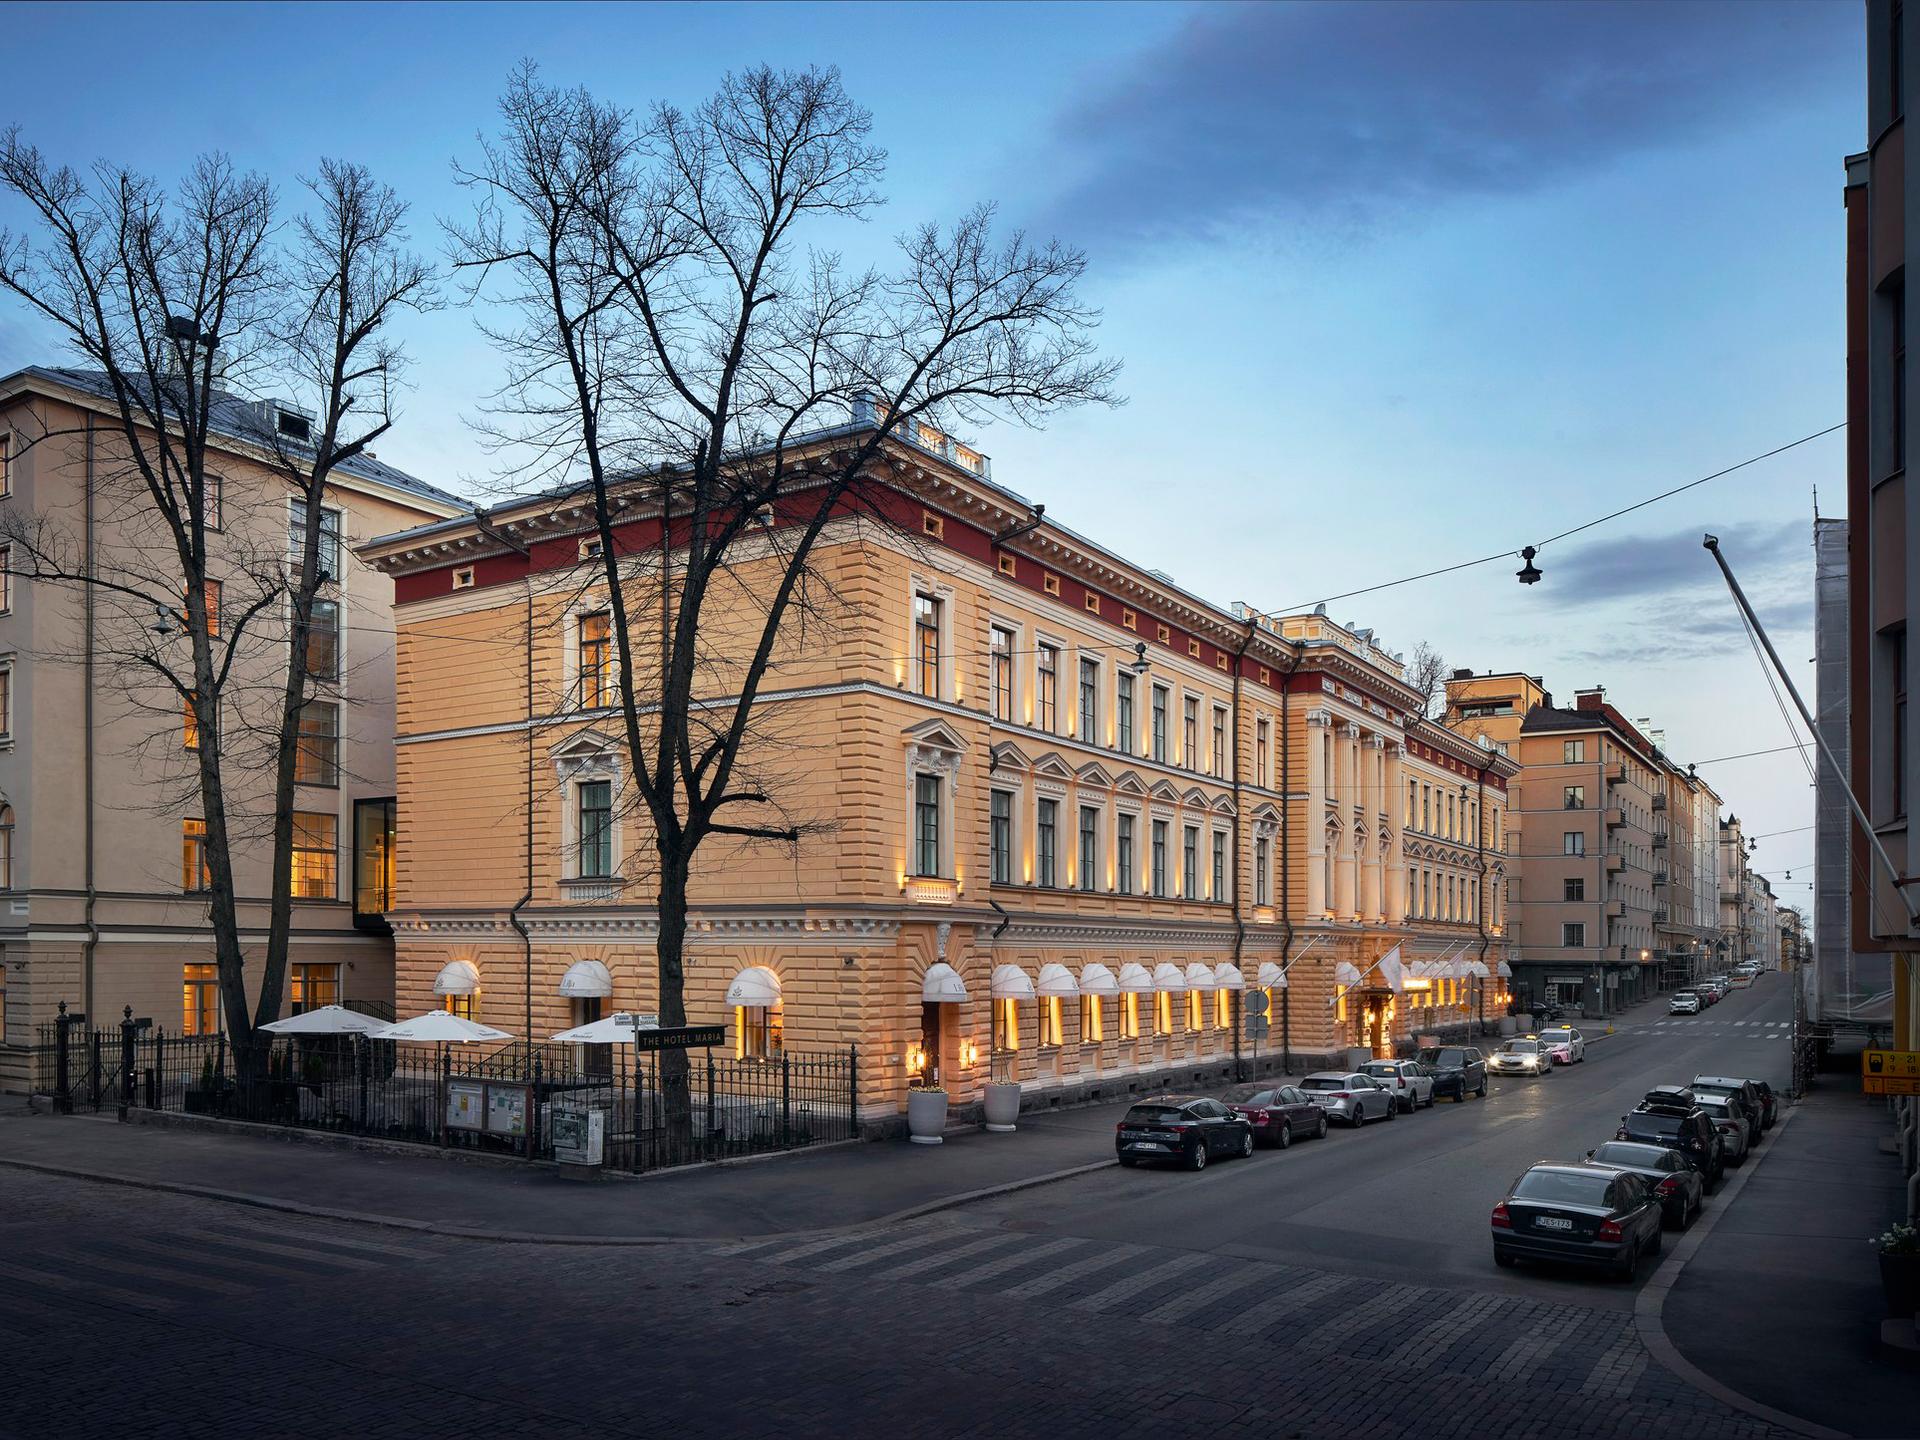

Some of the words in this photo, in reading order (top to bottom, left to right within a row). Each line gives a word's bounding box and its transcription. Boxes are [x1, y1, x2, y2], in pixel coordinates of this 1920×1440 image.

[642, 1037, 660, 1046] THE
[663, 1034, 692, 1045] HOTEL
[695, 1032, 721, 1042] MARIA
[1906, 1055, 1916, 1065] 21
